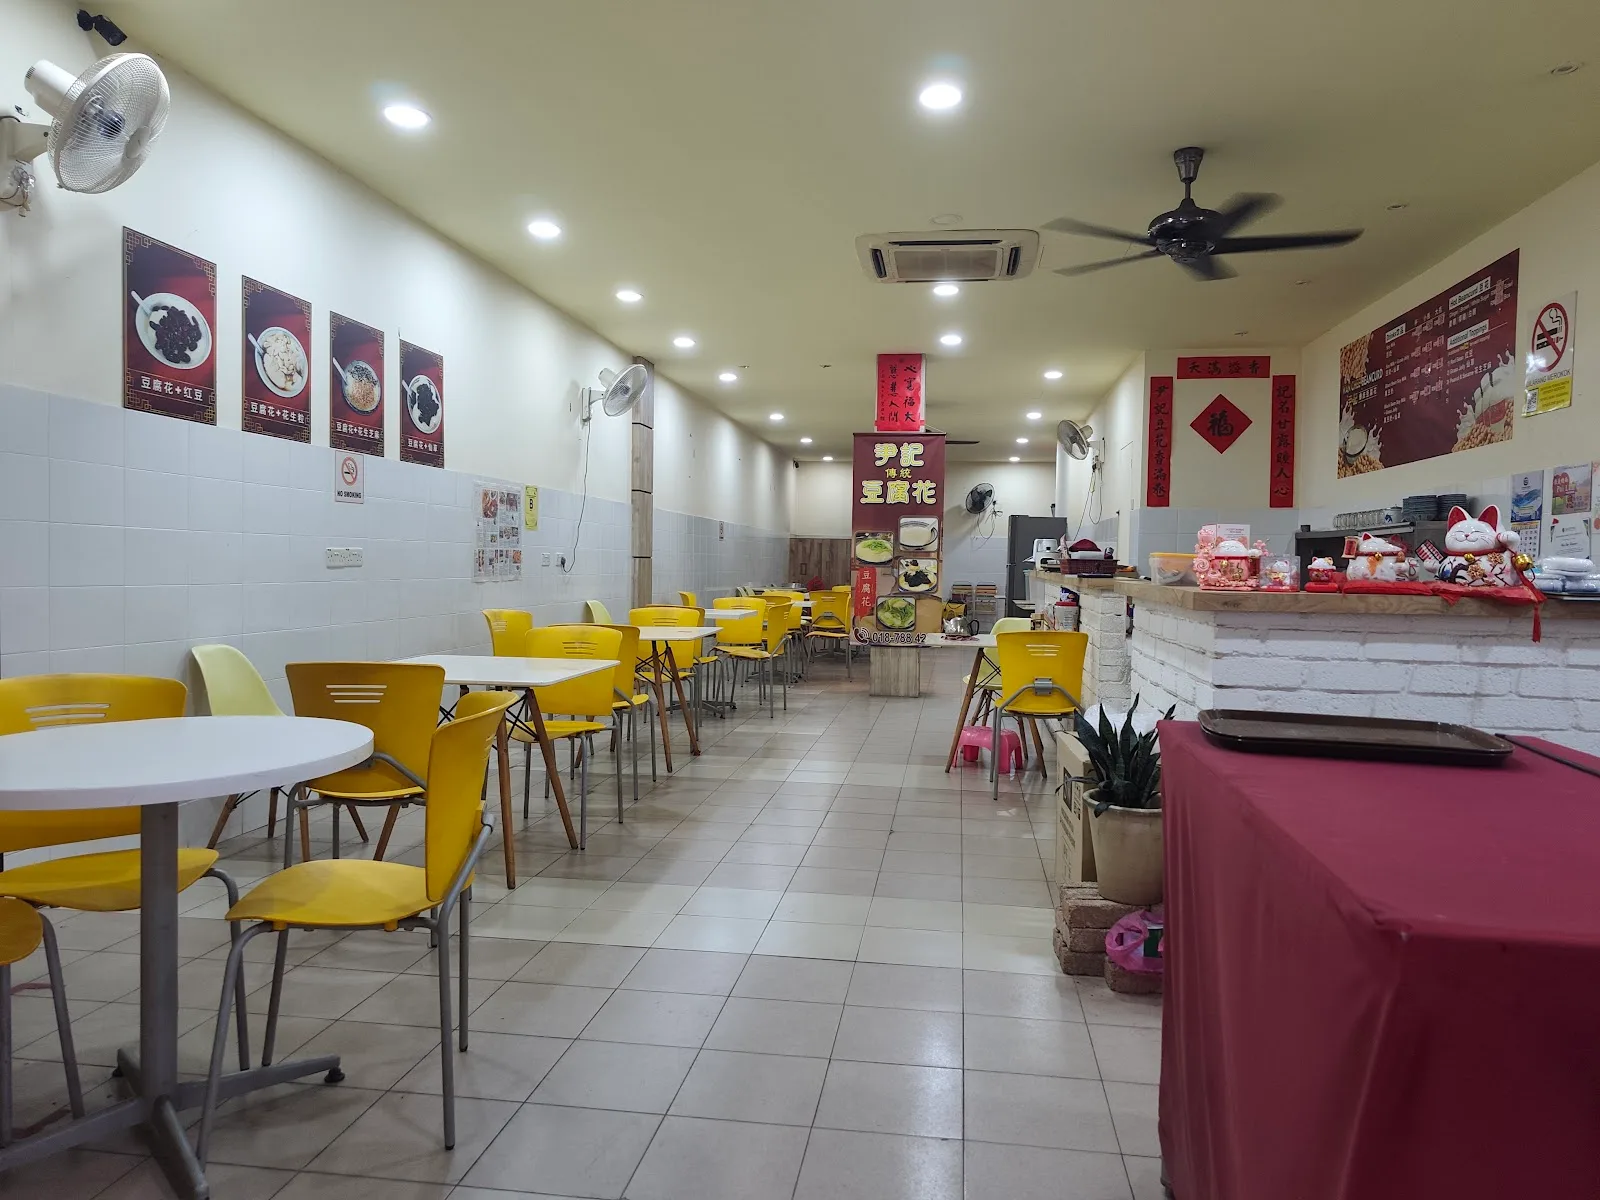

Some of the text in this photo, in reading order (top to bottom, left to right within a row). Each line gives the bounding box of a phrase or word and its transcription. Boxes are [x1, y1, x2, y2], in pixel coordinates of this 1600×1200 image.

[140, 375, 203, 402] 豆腐花+红豆
[1207, 410, 1233, 437] 福
[874, 442, 924, 467] 尹記
[529, 498, 533, 509] B
[860, 480, 936, 504] 豆腐花
[861, 570, 871, 607] 豆腐花
[872, 632, 912, 644] 018-788
